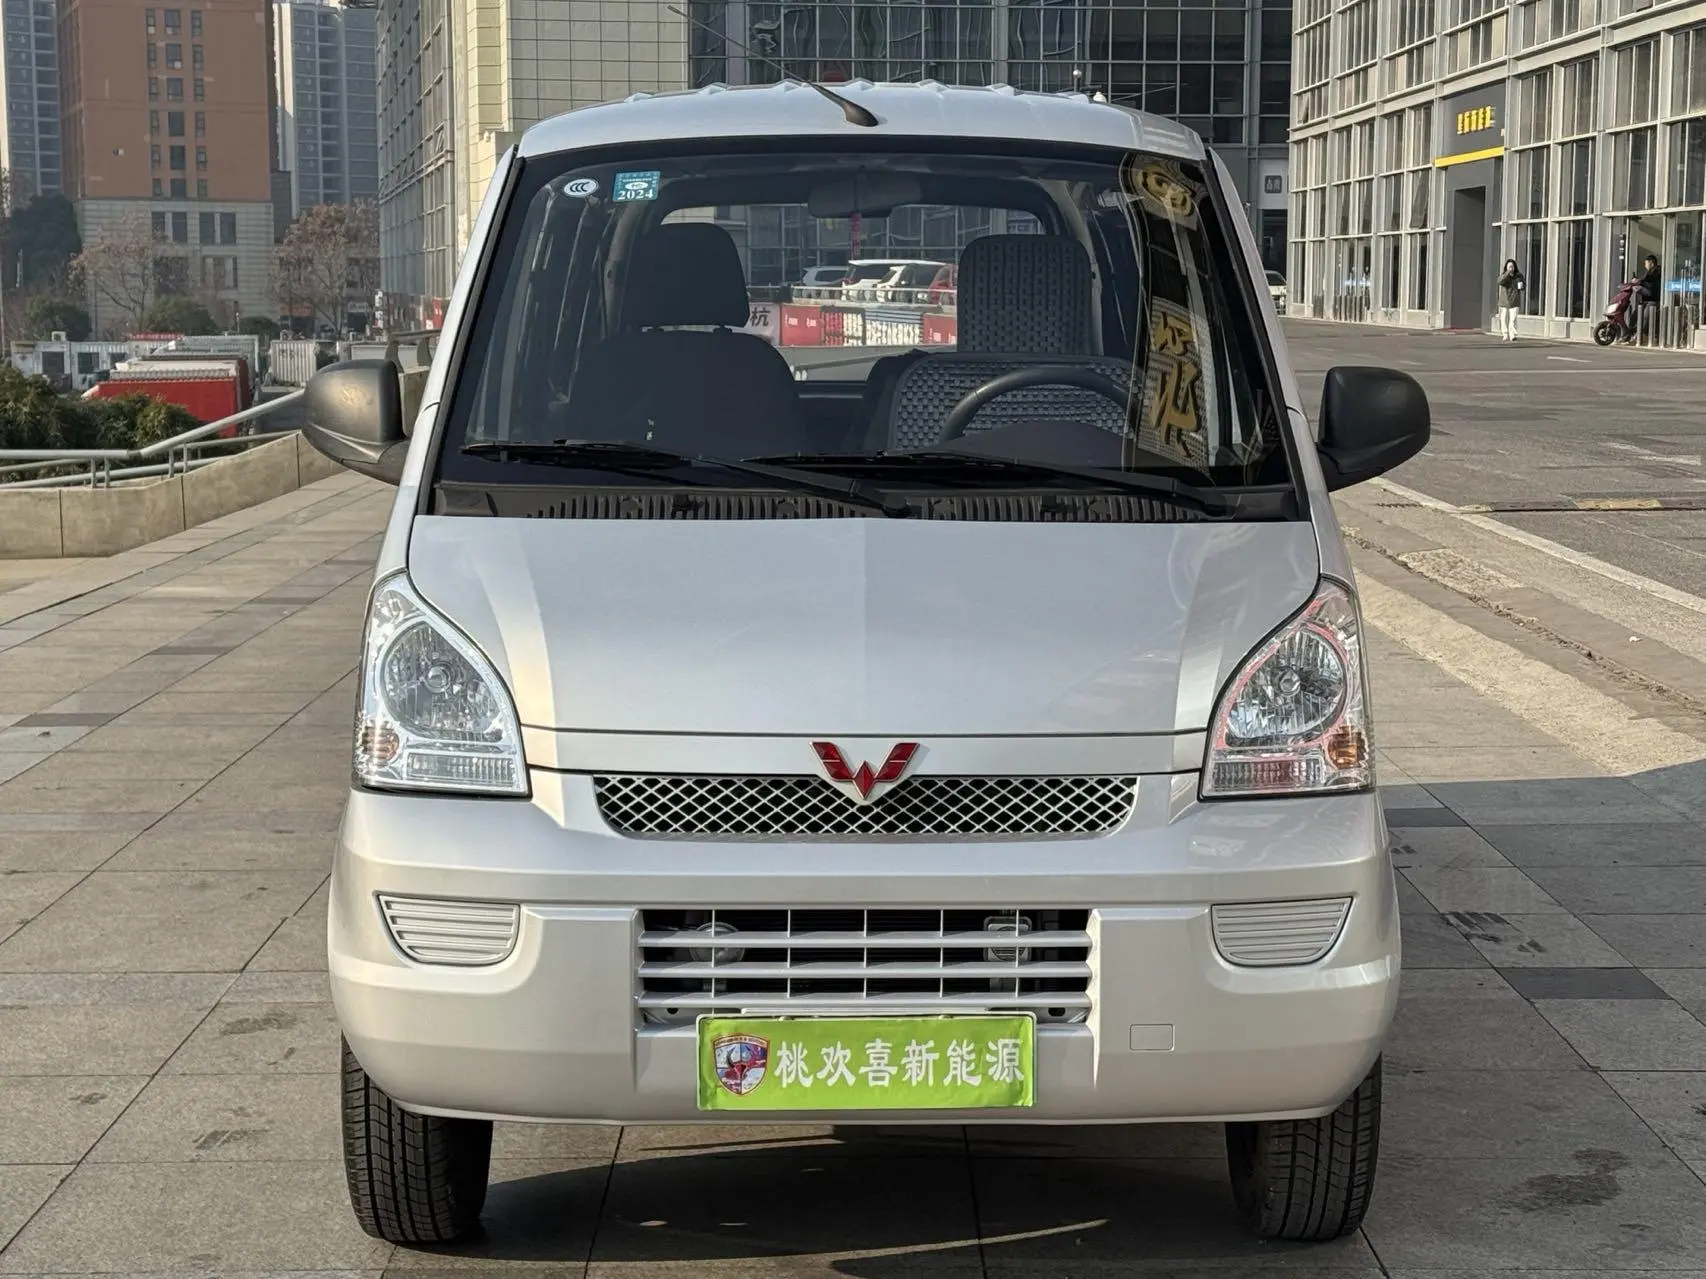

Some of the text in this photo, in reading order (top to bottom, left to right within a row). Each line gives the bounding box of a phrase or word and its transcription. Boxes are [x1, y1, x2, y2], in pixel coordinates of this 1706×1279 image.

[616, 189, 654, 200] 2024
[774, 1038, 1025, 1088] 桃欢喜新能源
